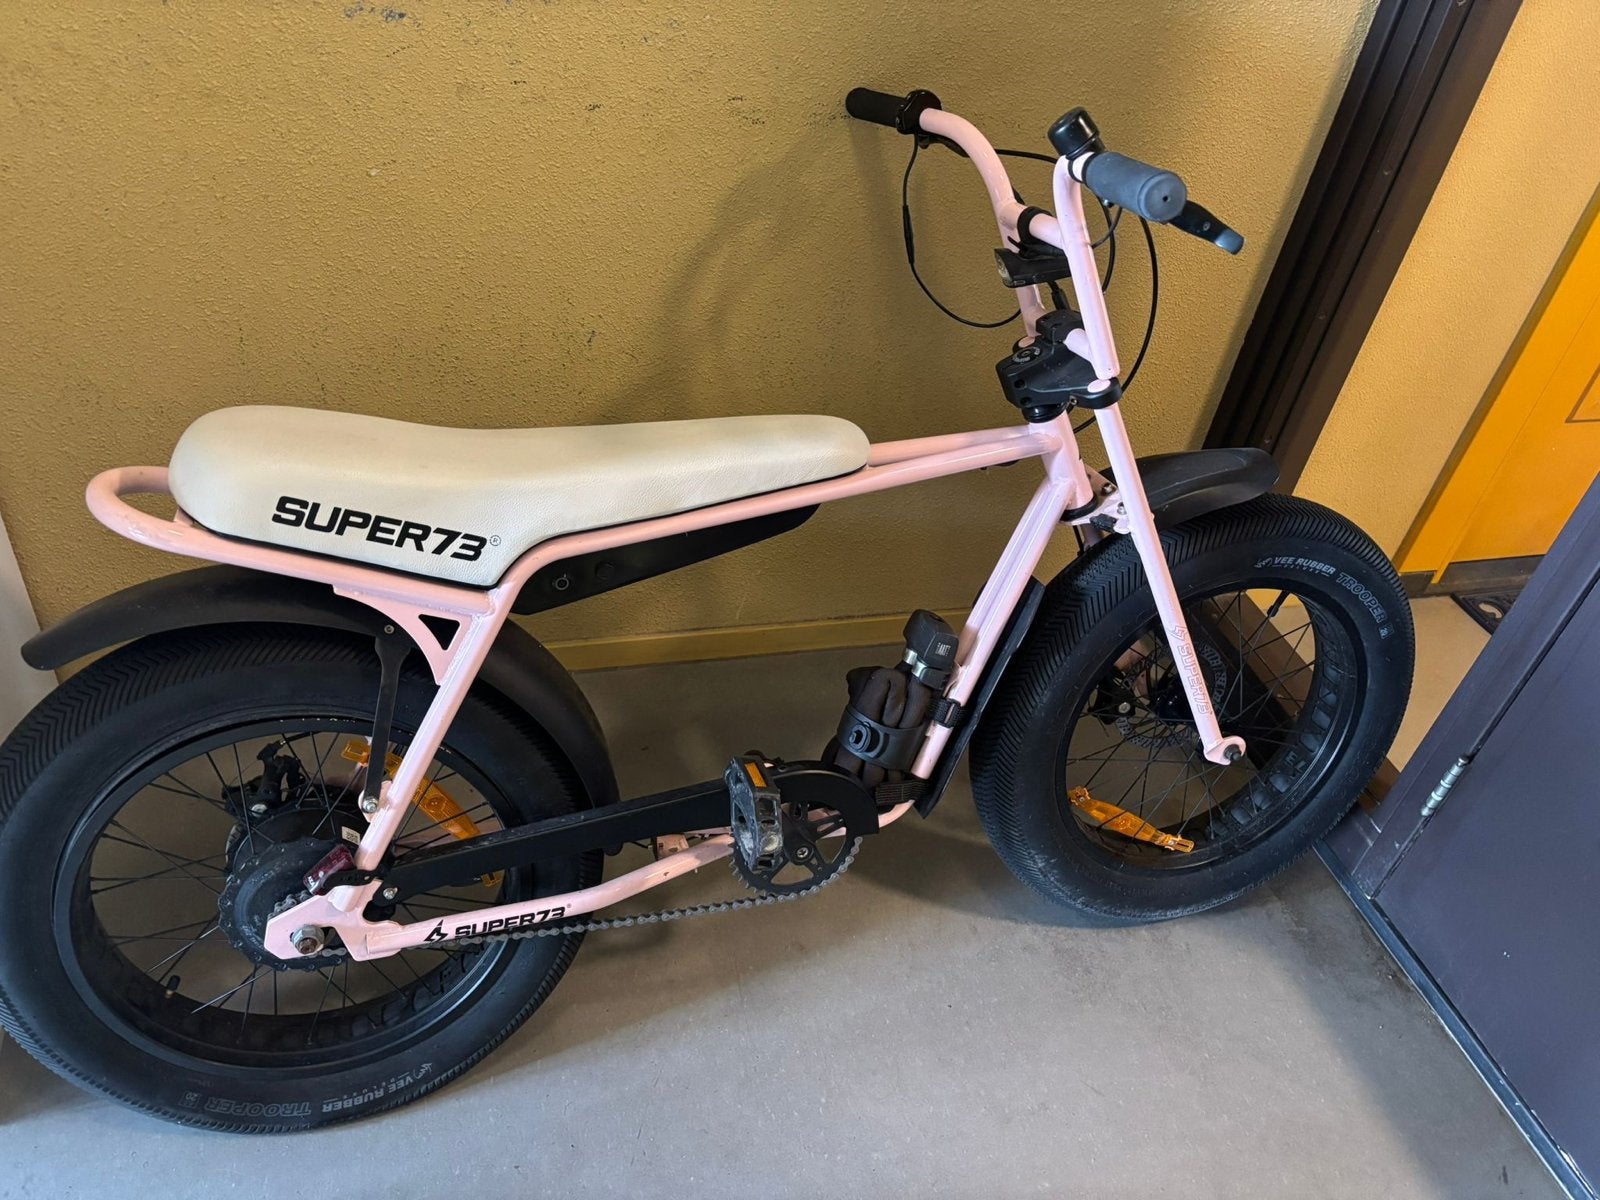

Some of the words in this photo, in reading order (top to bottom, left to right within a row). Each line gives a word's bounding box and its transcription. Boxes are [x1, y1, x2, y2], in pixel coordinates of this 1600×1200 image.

[1274, 556, 1295, 565] VEE
[1295, 558, 1337, 575] RUBBER
[1336, 571, 1387, 624] TROOPER
[1177, 642, 1211, 715] SUPER73
[387, 1075, 414, 1094] VEE
[204, 1096, 312, 1117] TROOPER
[321, 1087, 385, 1113] RUBBER
